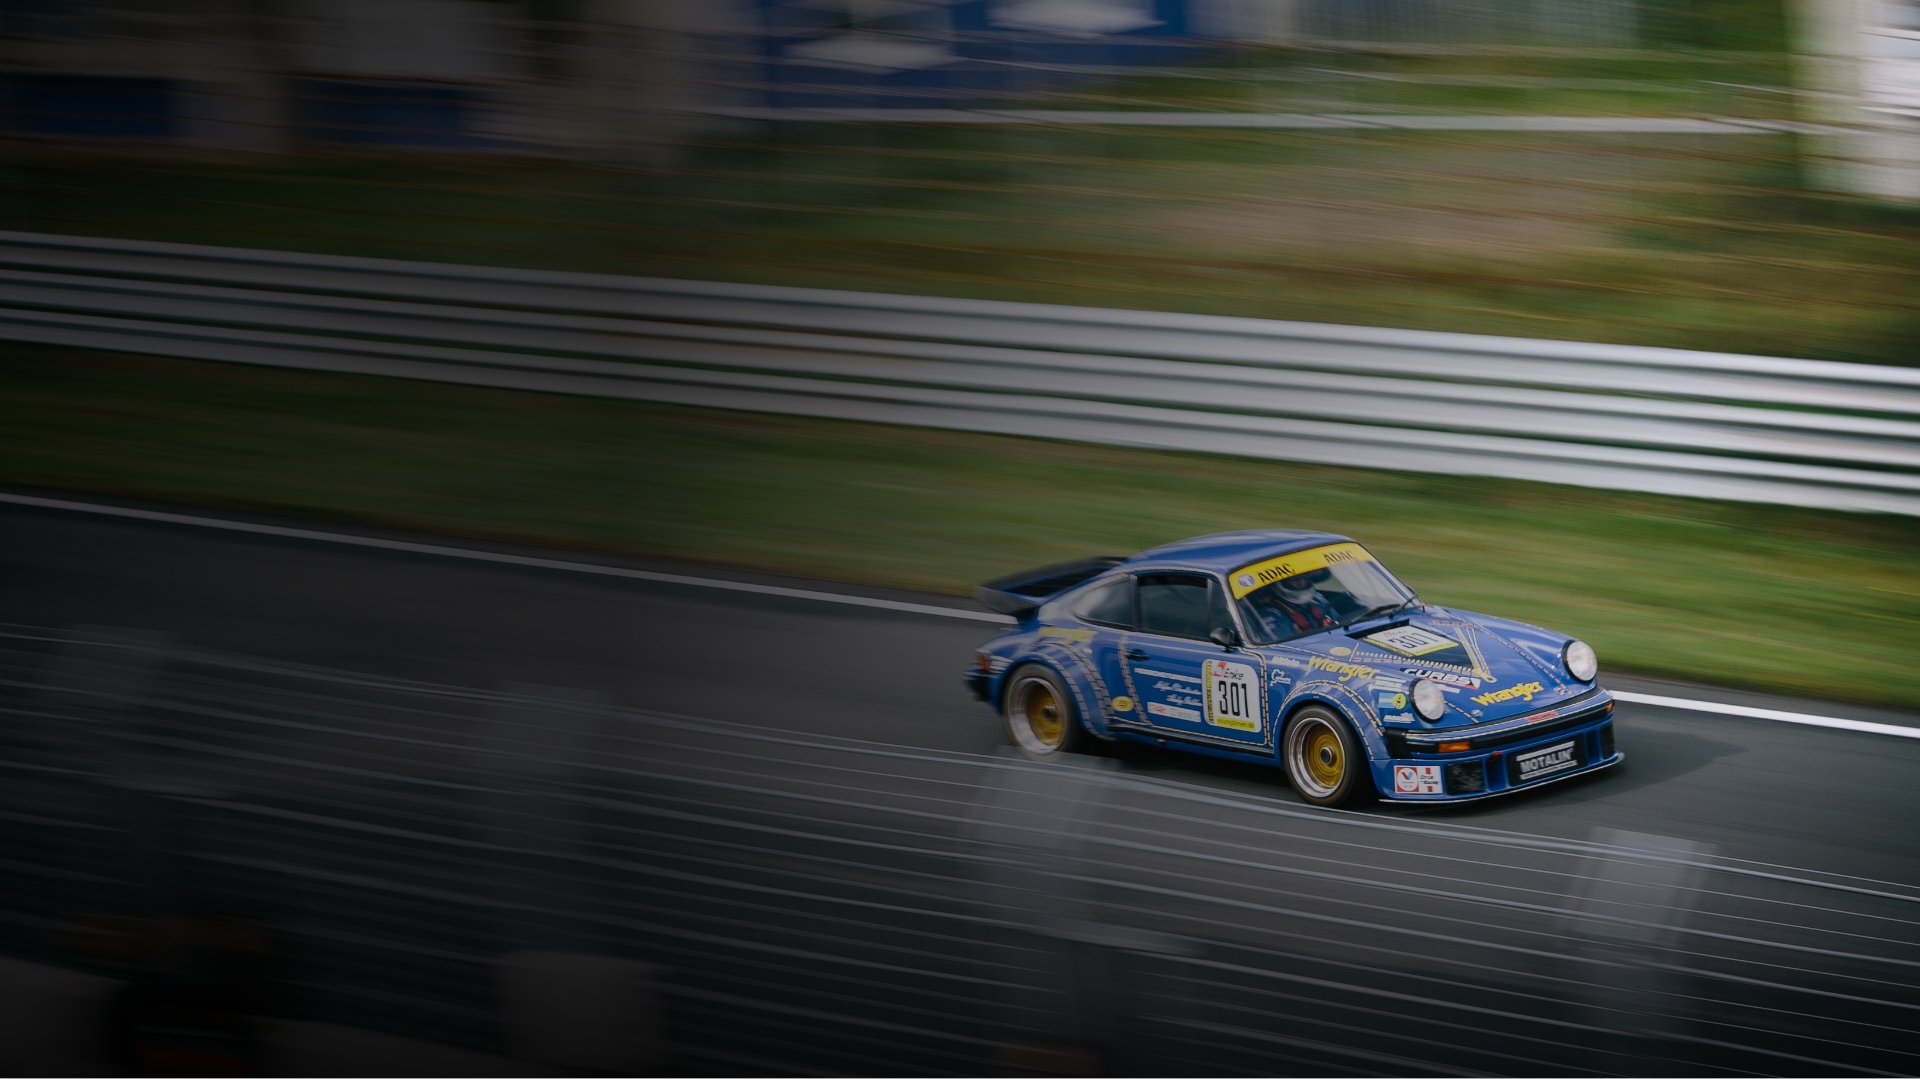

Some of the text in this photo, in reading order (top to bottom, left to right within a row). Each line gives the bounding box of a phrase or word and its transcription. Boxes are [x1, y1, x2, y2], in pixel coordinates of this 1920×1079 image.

[1323, 550, 1357, 565] ADAC
[1257, 563, 1295, 584] ADAC
[1388, 633, 1438, 649] 301
[1308, 655, 1380, 682] Wrangler
[1403, 668, 1473, 685] CURBS
[1218, 680, 1250, 718] 301
[1469, 681, 1545, 706] Wrangler
[1519, 749, 1573, 773] MOTALIN
